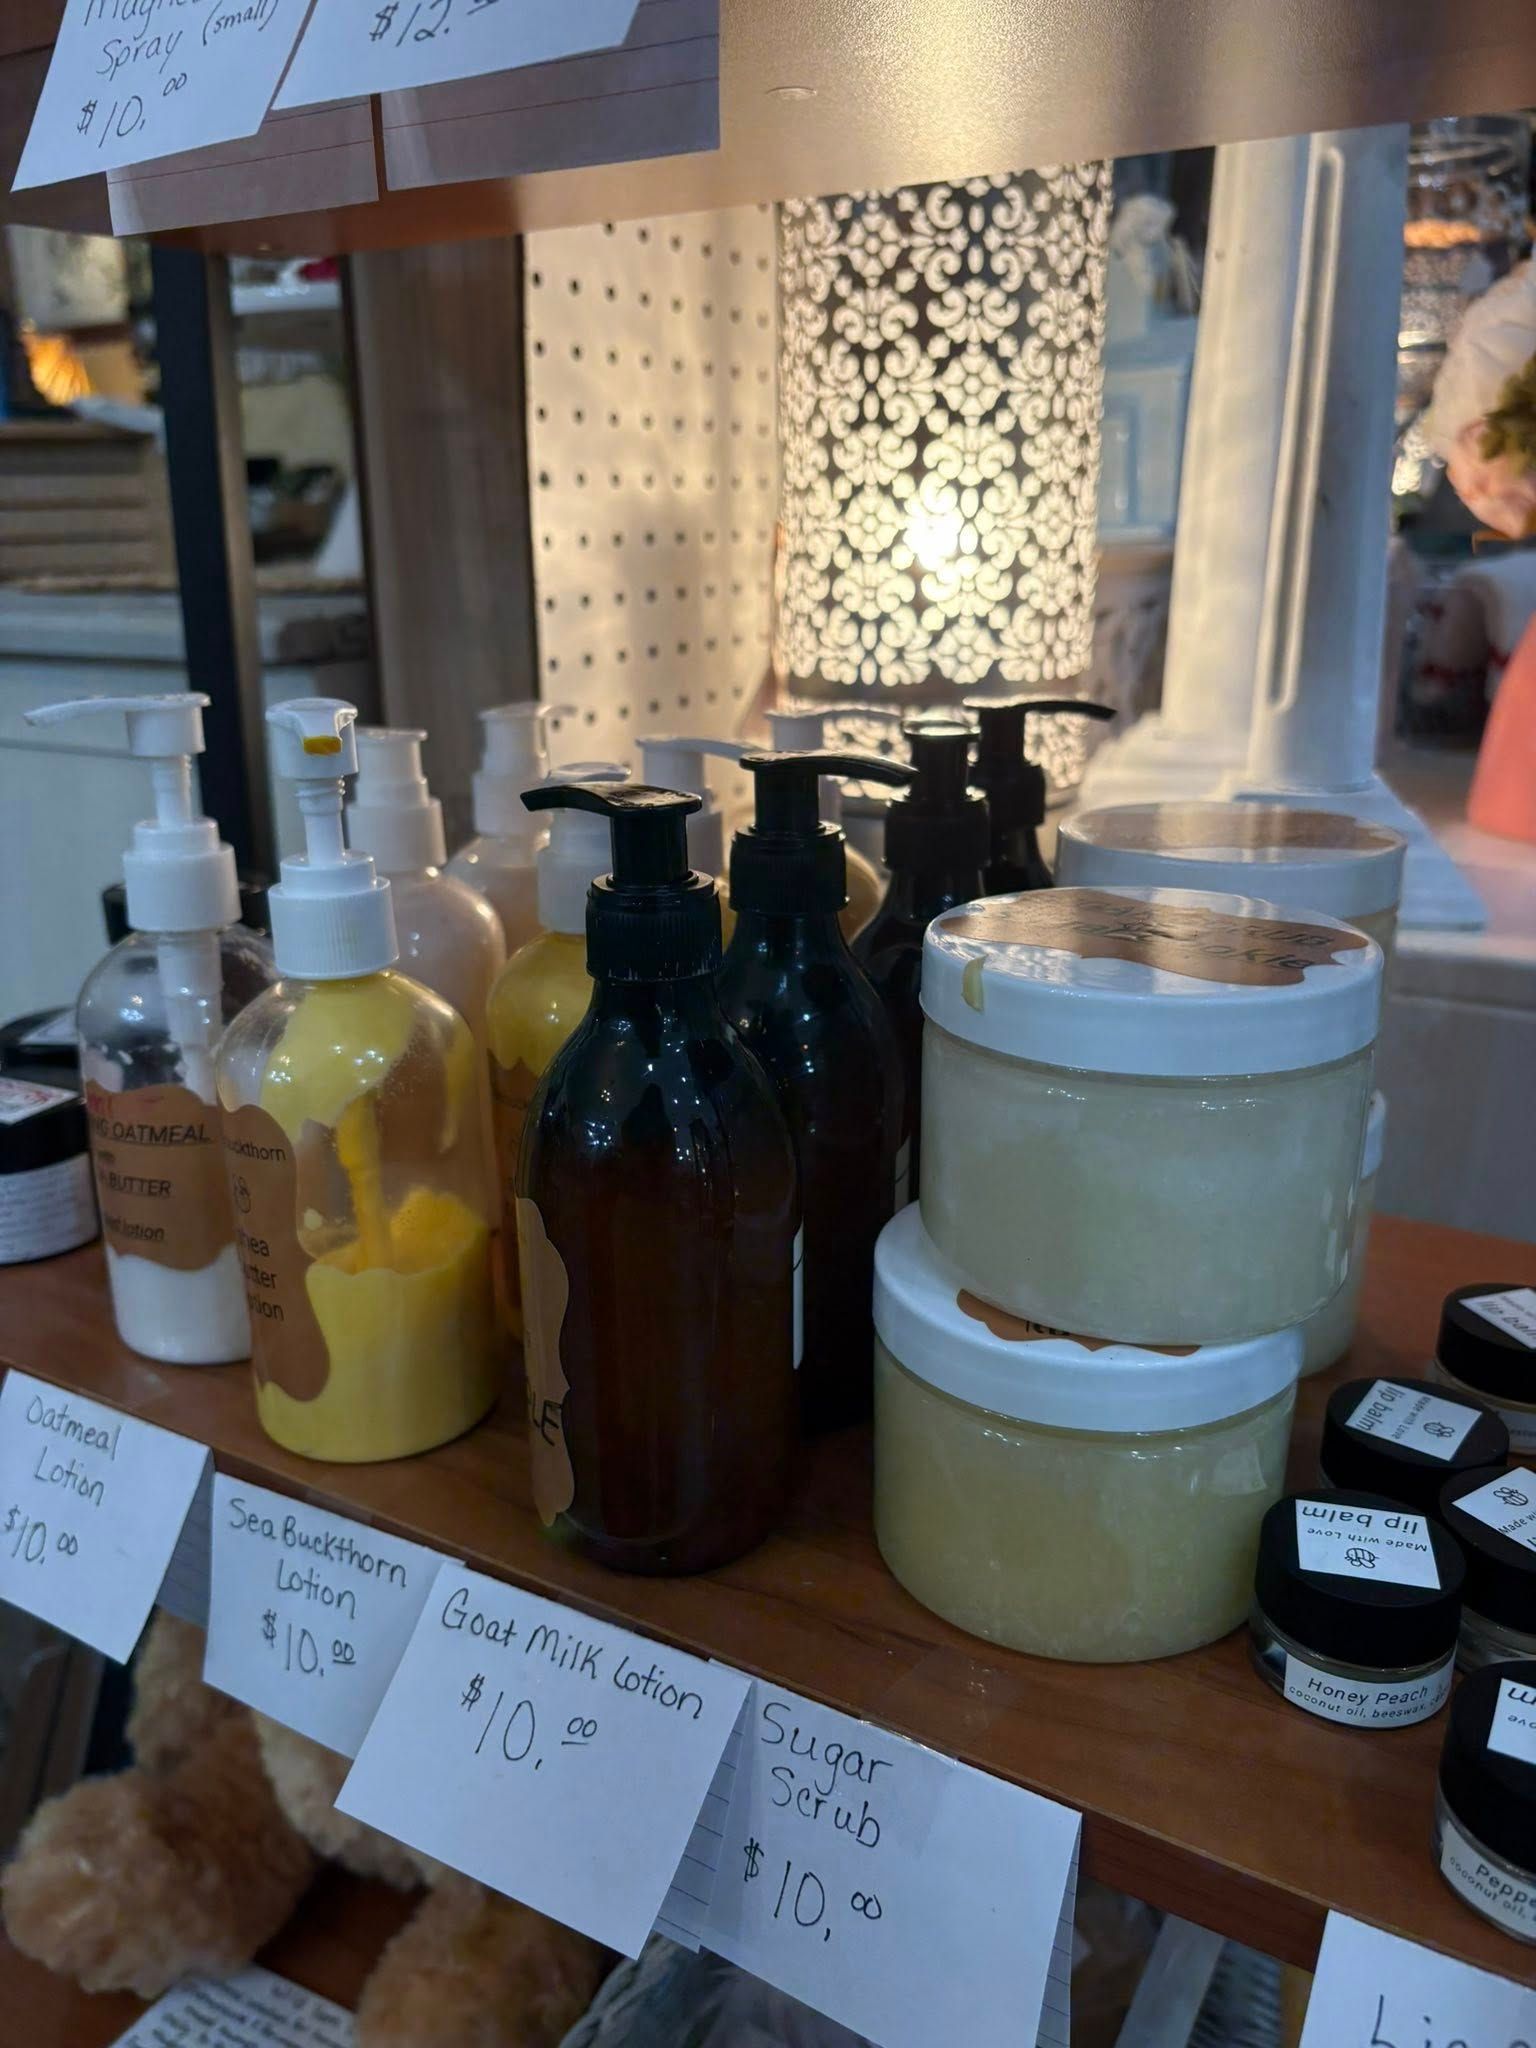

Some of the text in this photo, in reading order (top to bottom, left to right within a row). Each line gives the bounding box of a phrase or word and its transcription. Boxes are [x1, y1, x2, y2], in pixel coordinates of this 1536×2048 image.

[96, 31, 183, 82] Spray
[112, 1122, 211, 1146] OATMEAL
[108, 1170, 172, 1197] BUTTER
[26, 1395, 122, 1461] Oatmeal
[1355, 1402, 1393, 1431] balm
[34, 1445, 105, 1507] Lotion
[1301, 1505, 1419, 1535] lip balm
[1306, 1527, 1428, 1552] Made with Love
[1498, 1518, 1528, 1534] Made
[277, 1558, 356, 1620] Lotion
[441, 1587, 518, 1648] Goat
[612, 1655, 704, 1721] Lotion
[1288, 1685, 1342, 1713] coconut
[1346, 1707, 1367, 1719] oil,
[1307, 1677, 1369, 1706] Honey
[1375, 1685, 1429, 1705] Peach
[760, 1702, 894, 1796] Sugar
[771, 1765, 881, 1849] Scrub
[1449, 1856, 1499, 1901] coconut
